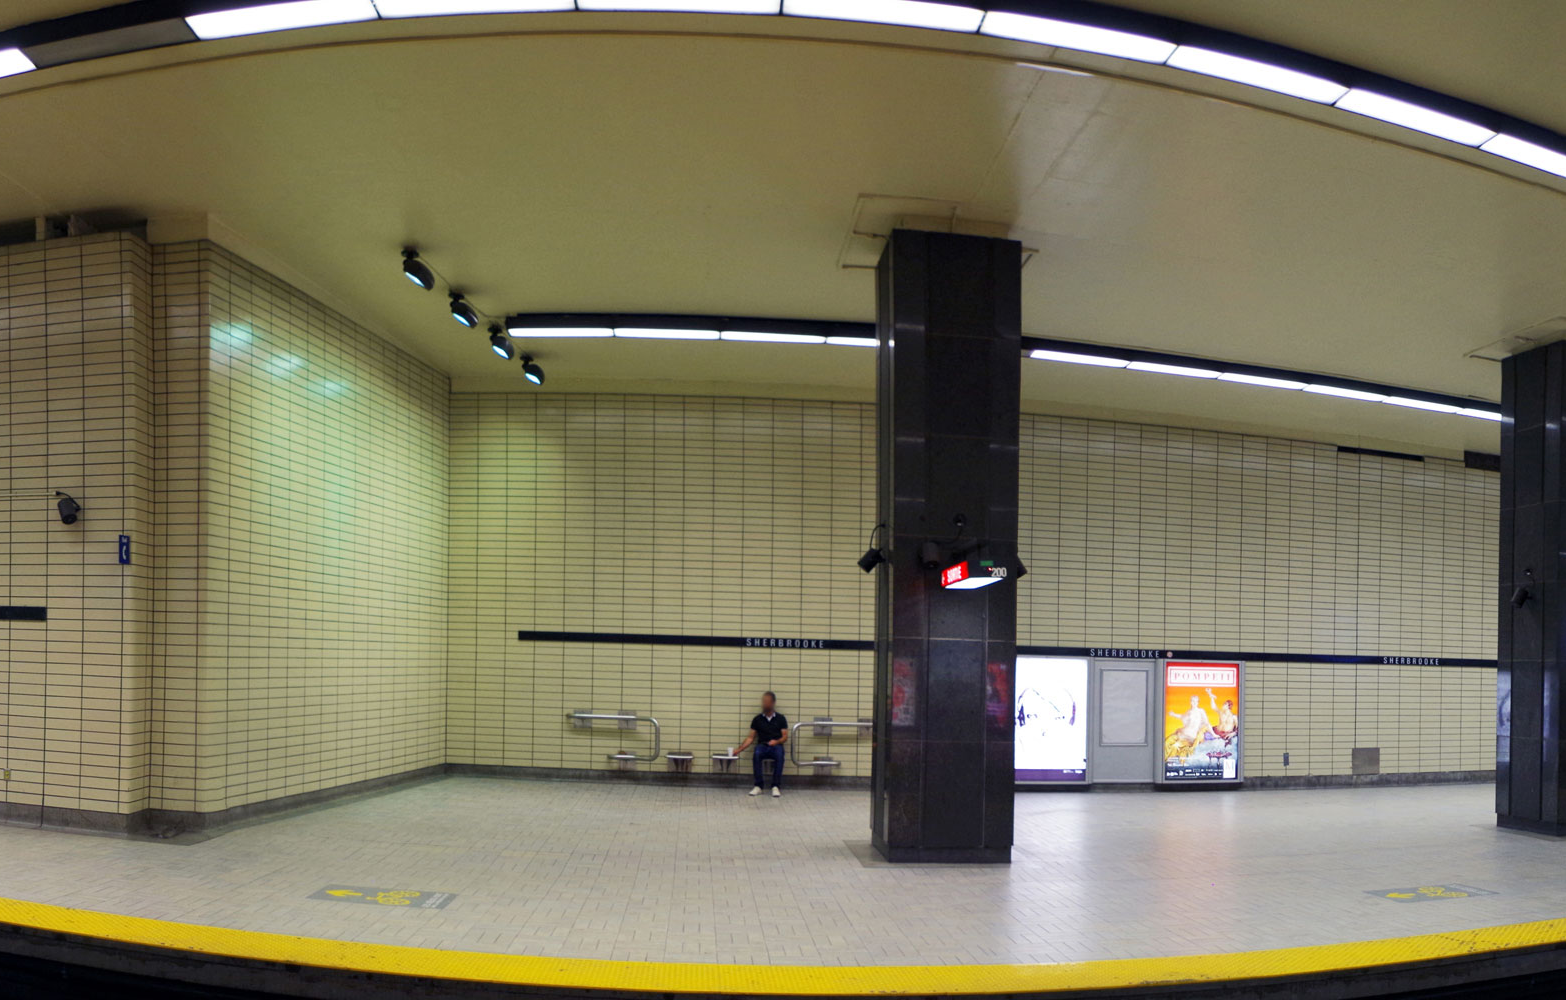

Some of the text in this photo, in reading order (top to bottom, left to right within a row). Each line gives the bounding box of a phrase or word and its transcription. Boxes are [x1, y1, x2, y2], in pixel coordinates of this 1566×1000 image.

[991, 567, 1007, 577] 200
[746, 638, 824, 649] SHERBROOKE
[1090, 649, 1160, 658] SHERBROOKE
[1383, 656, 1439, 666] SHERBROOKE
[1174, 672, 1231, 681] POMPEII
